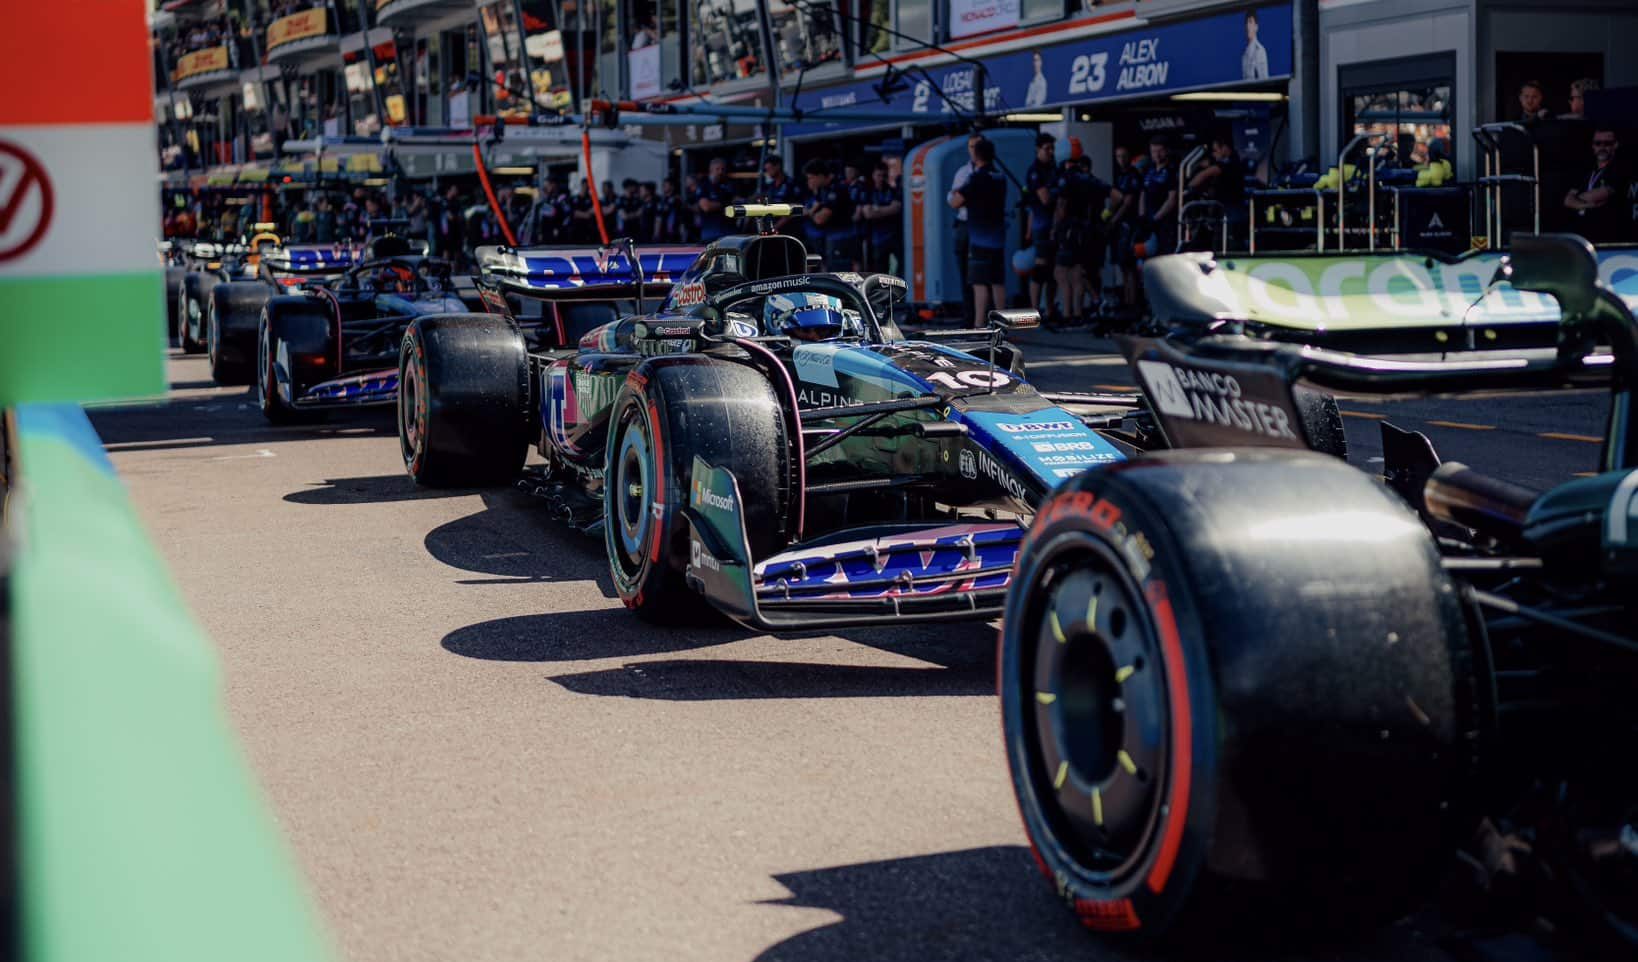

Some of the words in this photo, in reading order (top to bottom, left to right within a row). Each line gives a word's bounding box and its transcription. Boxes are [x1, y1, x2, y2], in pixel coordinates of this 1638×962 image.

[1119, 38, 1160, 65] ALEX
[1068, 52, 1108, 94] 23
[1115, 61, 1169, 91] ALBON
[751, 281, 783, 294] amazon
[783, 275, 811, 289] music
[664, 326, 690, 336] Castrol
[926, 370, 1010, 390] 10
[1174, 367, 1241, 398] BANCO
[1024, 422, 1073, 432] BWT
[1191, 392, 1296, 440] MASTER
[1038, 453, 1116, 463] MOBILIZE
[979, 451, 1026, 500] INFINOX
[702, 487, 734, 512] Microsoft
